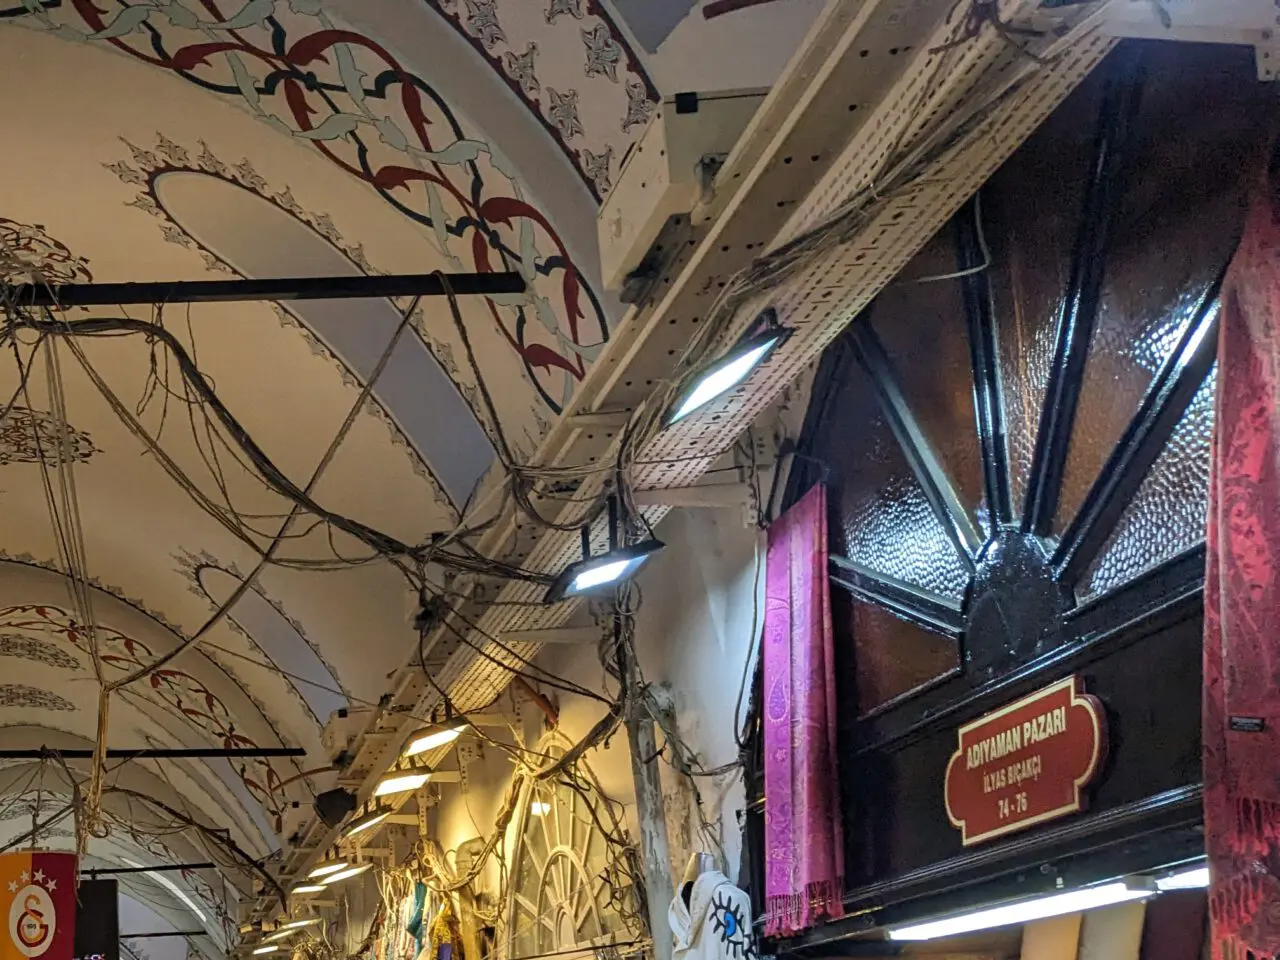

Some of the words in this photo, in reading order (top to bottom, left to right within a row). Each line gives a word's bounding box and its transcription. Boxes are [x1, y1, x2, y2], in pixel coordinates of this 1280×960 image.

[966, 726, 1021, 771] ADIYAMAN
[998, 798, 1010, 819] 74
[1016, 792, 1028, 813] 76
